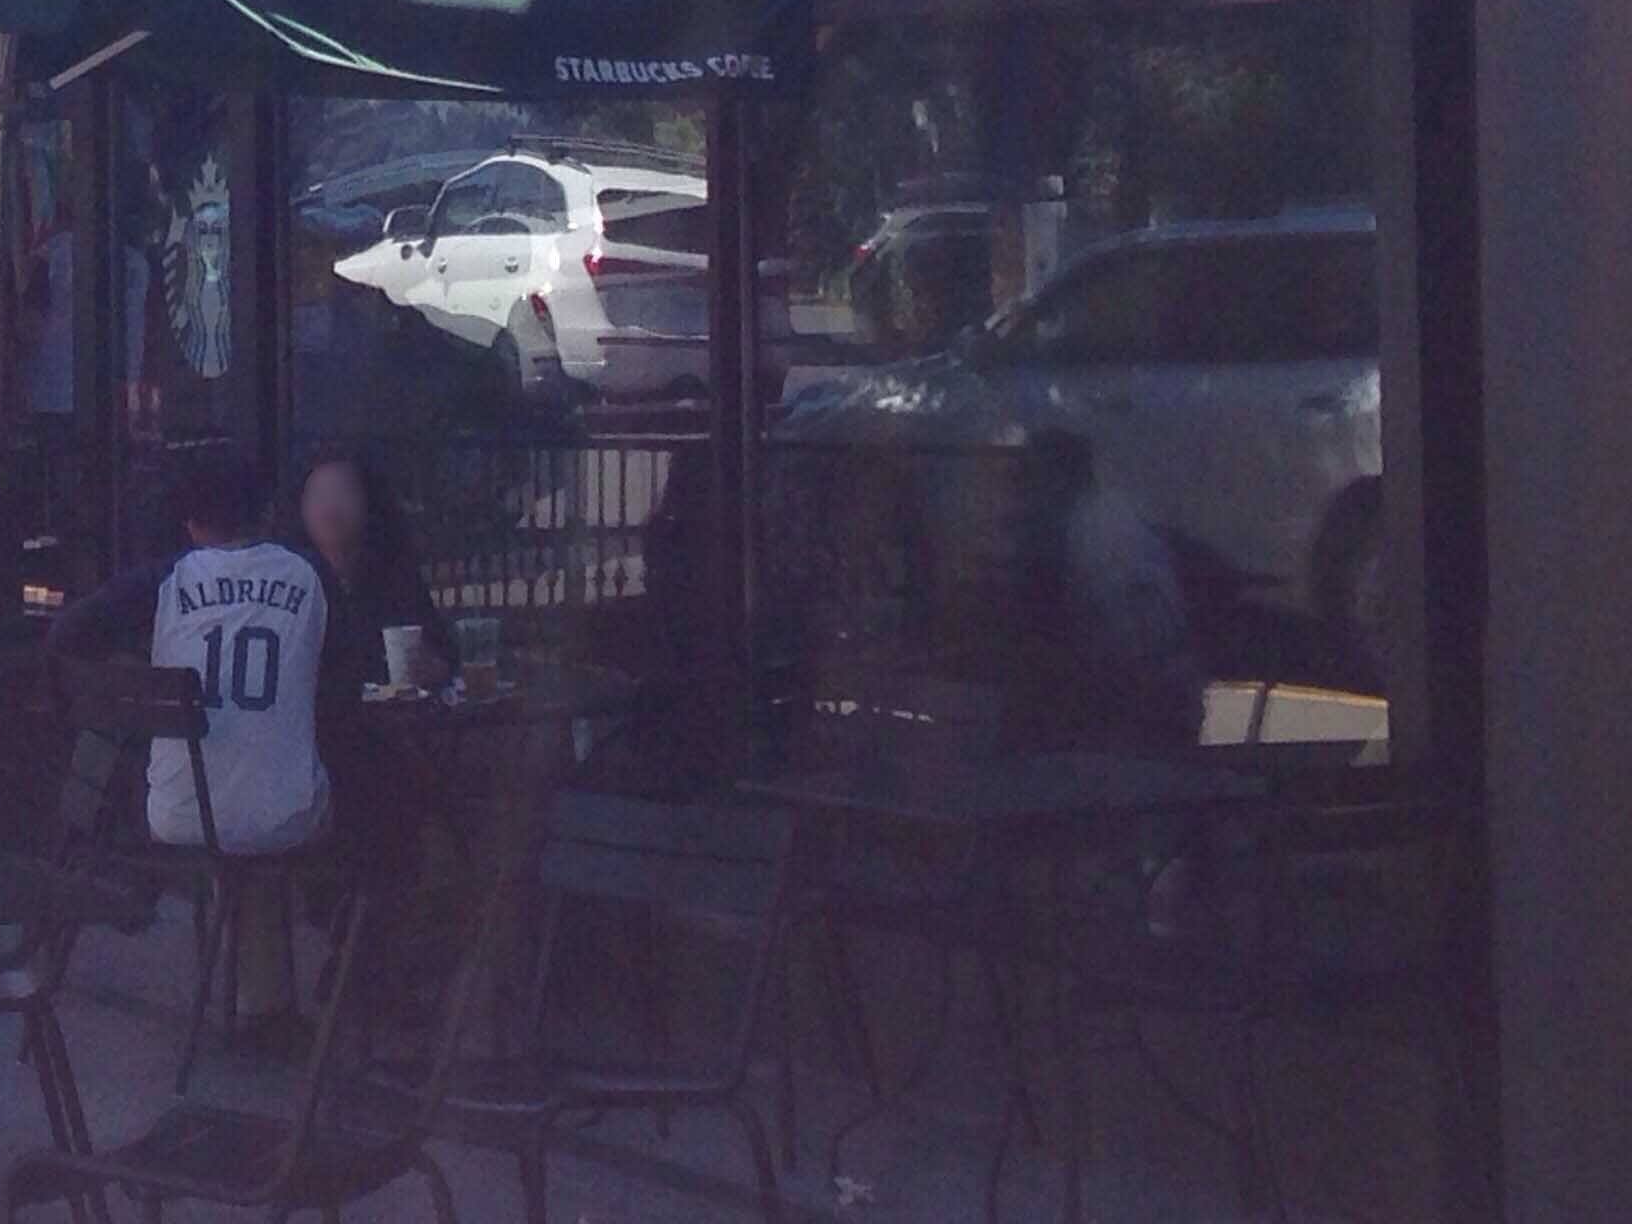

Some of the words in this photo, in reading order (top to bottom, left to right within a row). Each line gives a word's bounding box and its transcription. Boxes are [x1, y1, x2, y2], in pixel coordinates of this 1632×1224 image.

[554, 55, 704, 83] STARBUCKS
[706, 53, 775, 80] COFEE
[176, 577, 307, 616] ALDRICH
[199, 624, 281, 712] 10
